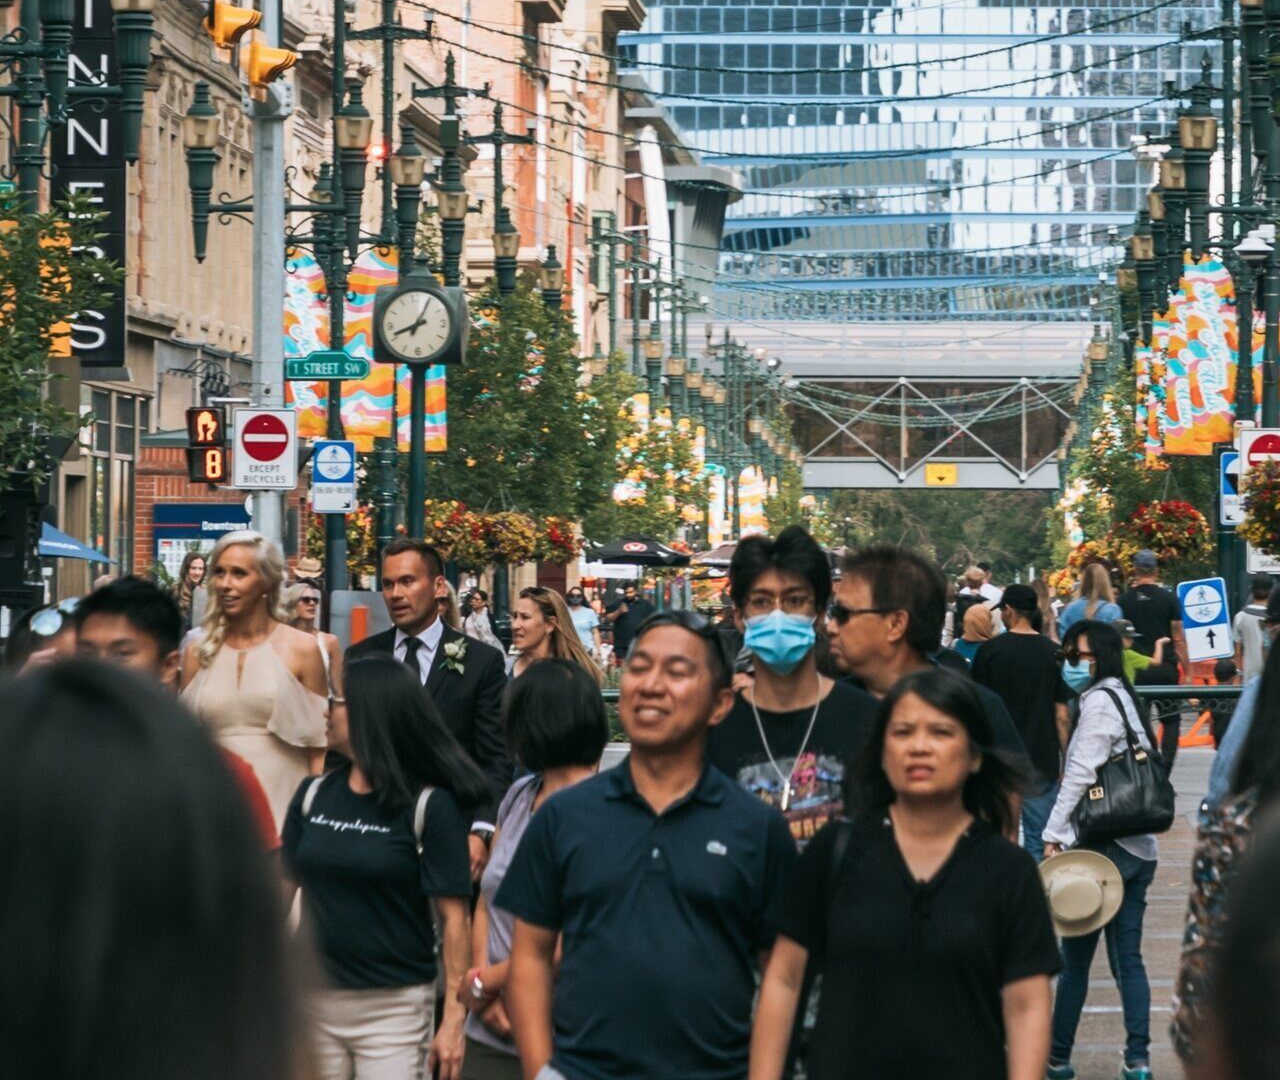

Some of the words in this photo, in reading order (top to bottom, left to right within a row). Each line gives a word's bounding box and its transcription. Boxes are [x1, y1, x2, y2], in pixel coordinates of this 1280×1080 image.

[440, 319, 447, 329] 3
[414, 346, 422, 356] 6
[293, 363, 299, 375] 1
[303, 362, 339, 375] STREET
[344, 362, 361, 375] SW
[205, 449, 222, 479] 8
[248, 464, 281, 473] EXCEPT
[242, 474, 287, 484] BICYCLES
[201, 521, 248, 531] Downtown
